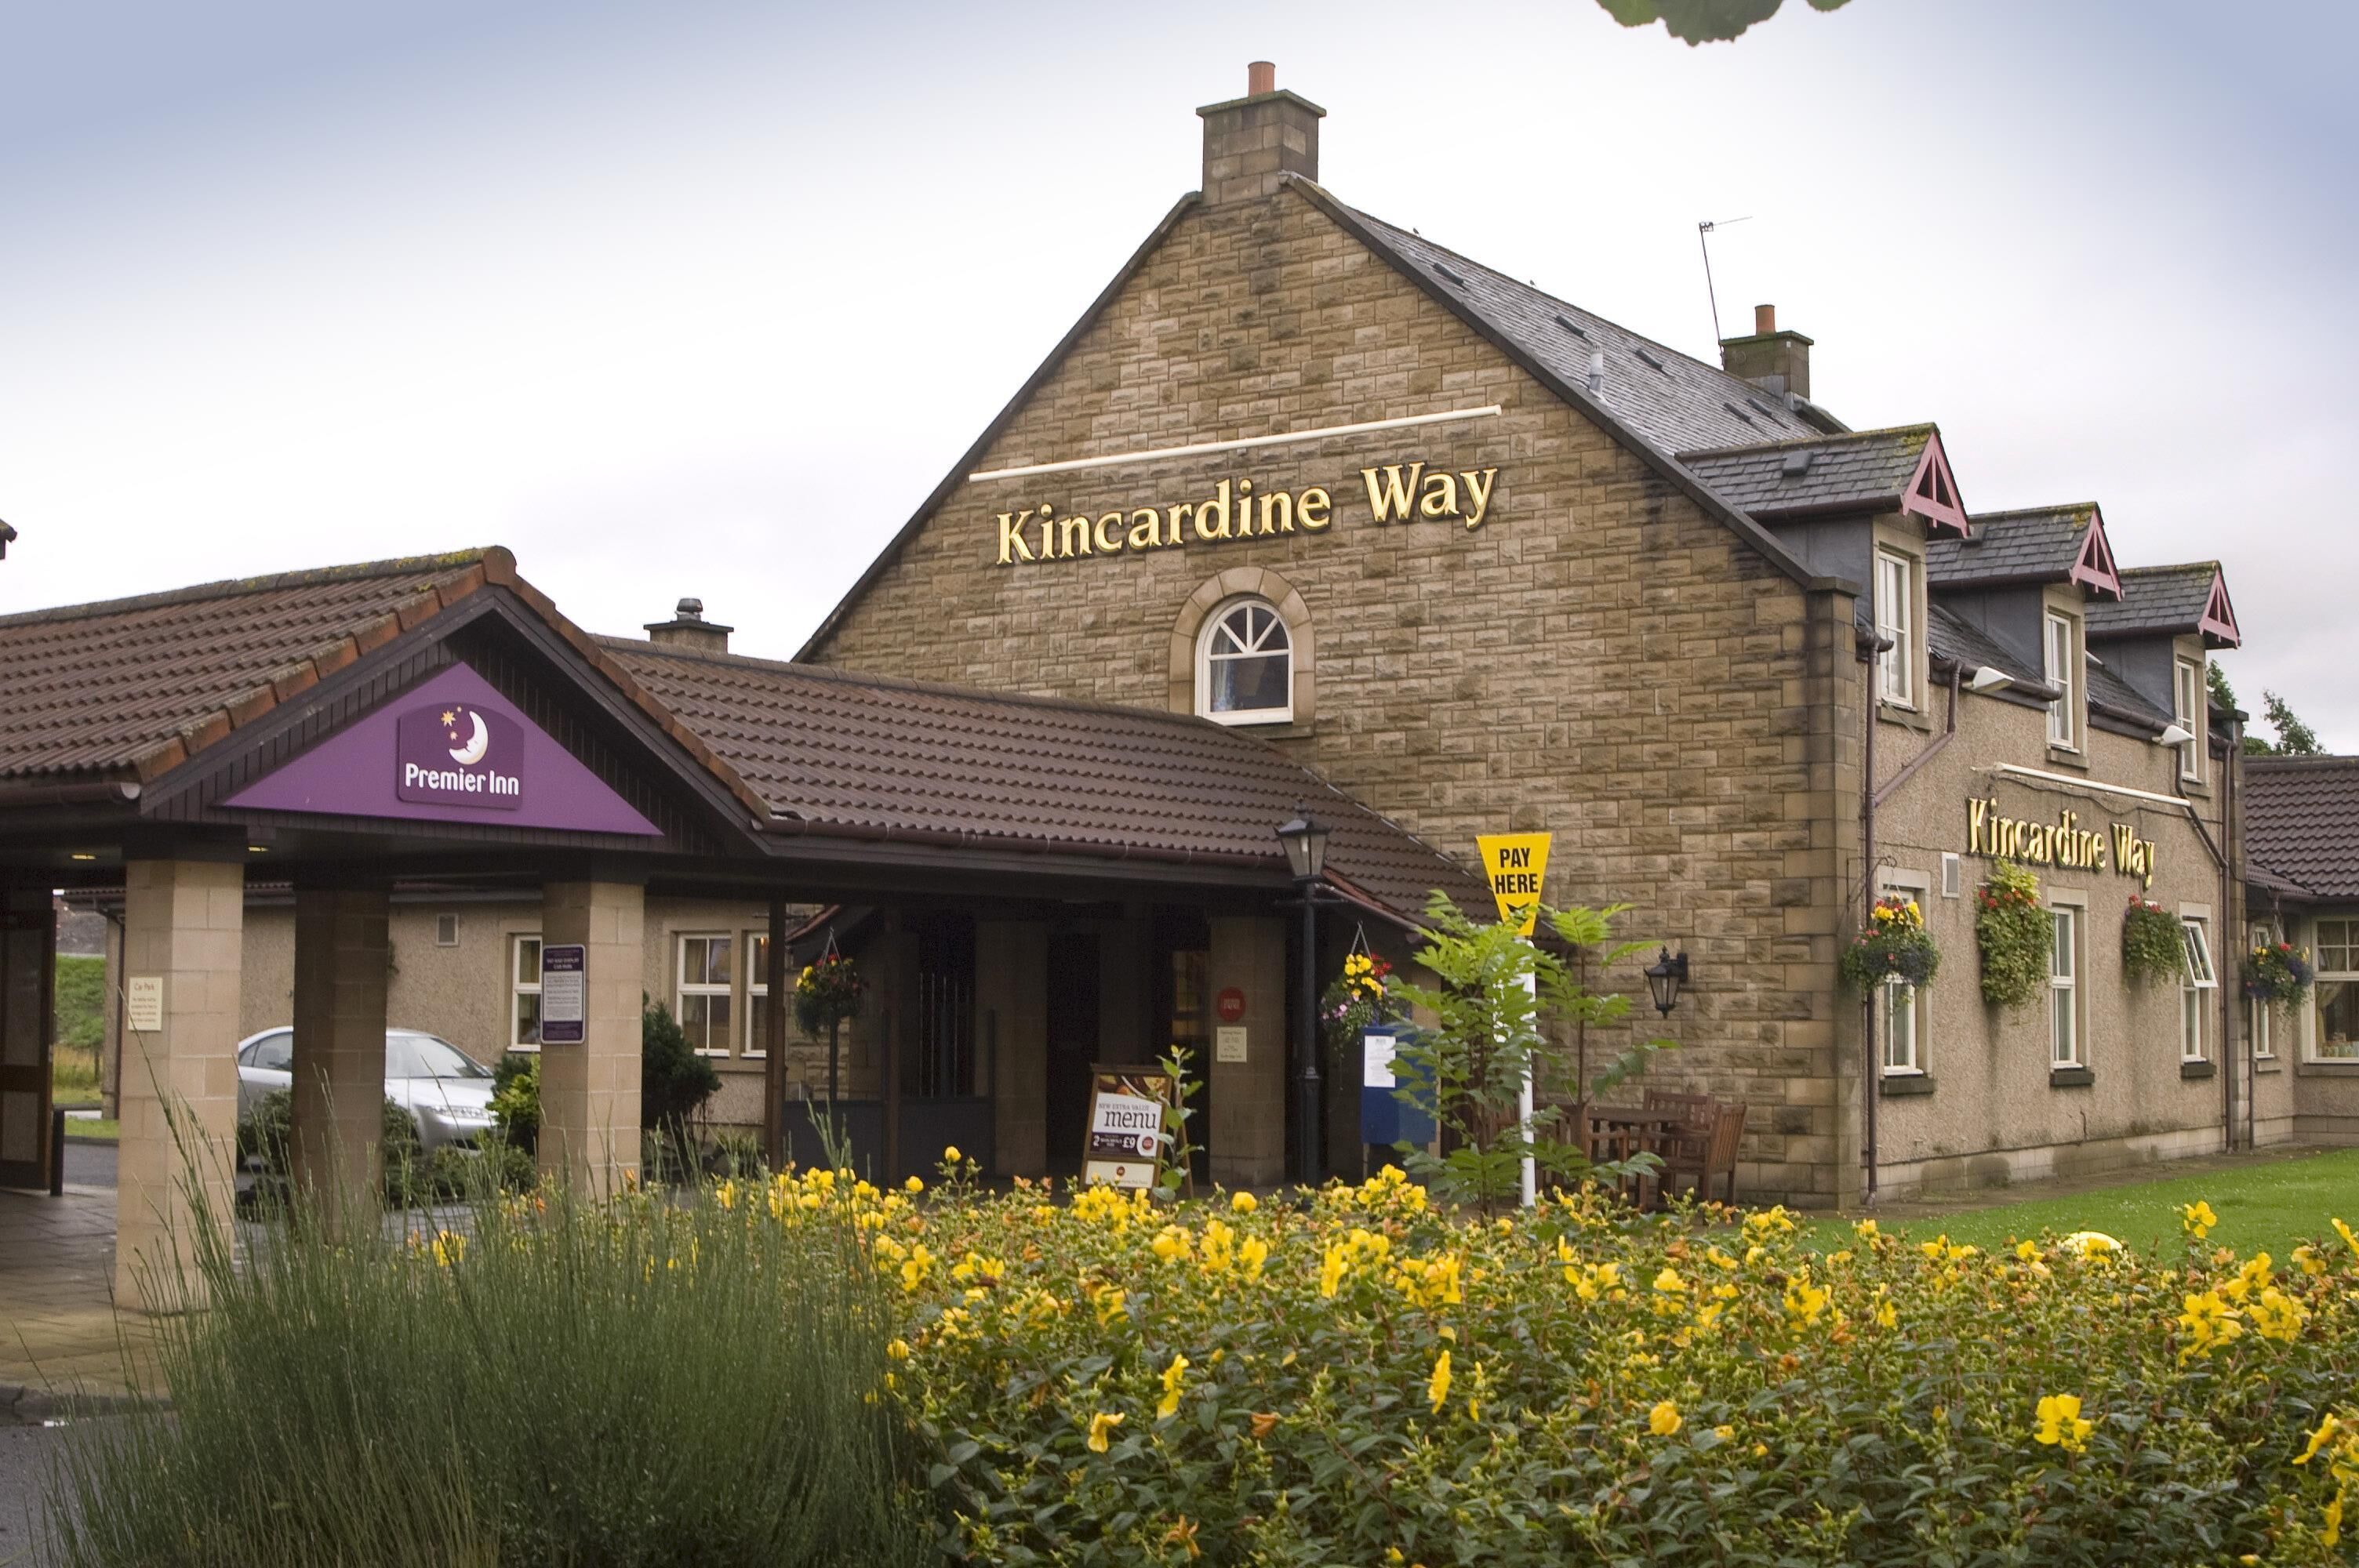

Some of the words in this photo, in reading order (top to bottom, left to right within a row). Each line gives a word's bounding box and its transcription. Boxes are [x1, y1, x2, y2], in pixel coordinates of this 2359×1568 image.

[996, 478, 1331, 566] Kincardine
[1361, 461, 1498, 531] Way
[405, 763, 487, 793] Premier
[489, 770, 519, 796] Inn
[1967, 797, 2106, 872] Kincardine
[2110, 822, 2155, 890] Way
[1499, 848, 1531, 869] PAY
[1494, 873, 1539, 895] HERE
[1104, 1111, 1157, 1129] menu
[1092, 1135, 1100, 1147] 2
[1122, 1136, 1136, 1149] £9
